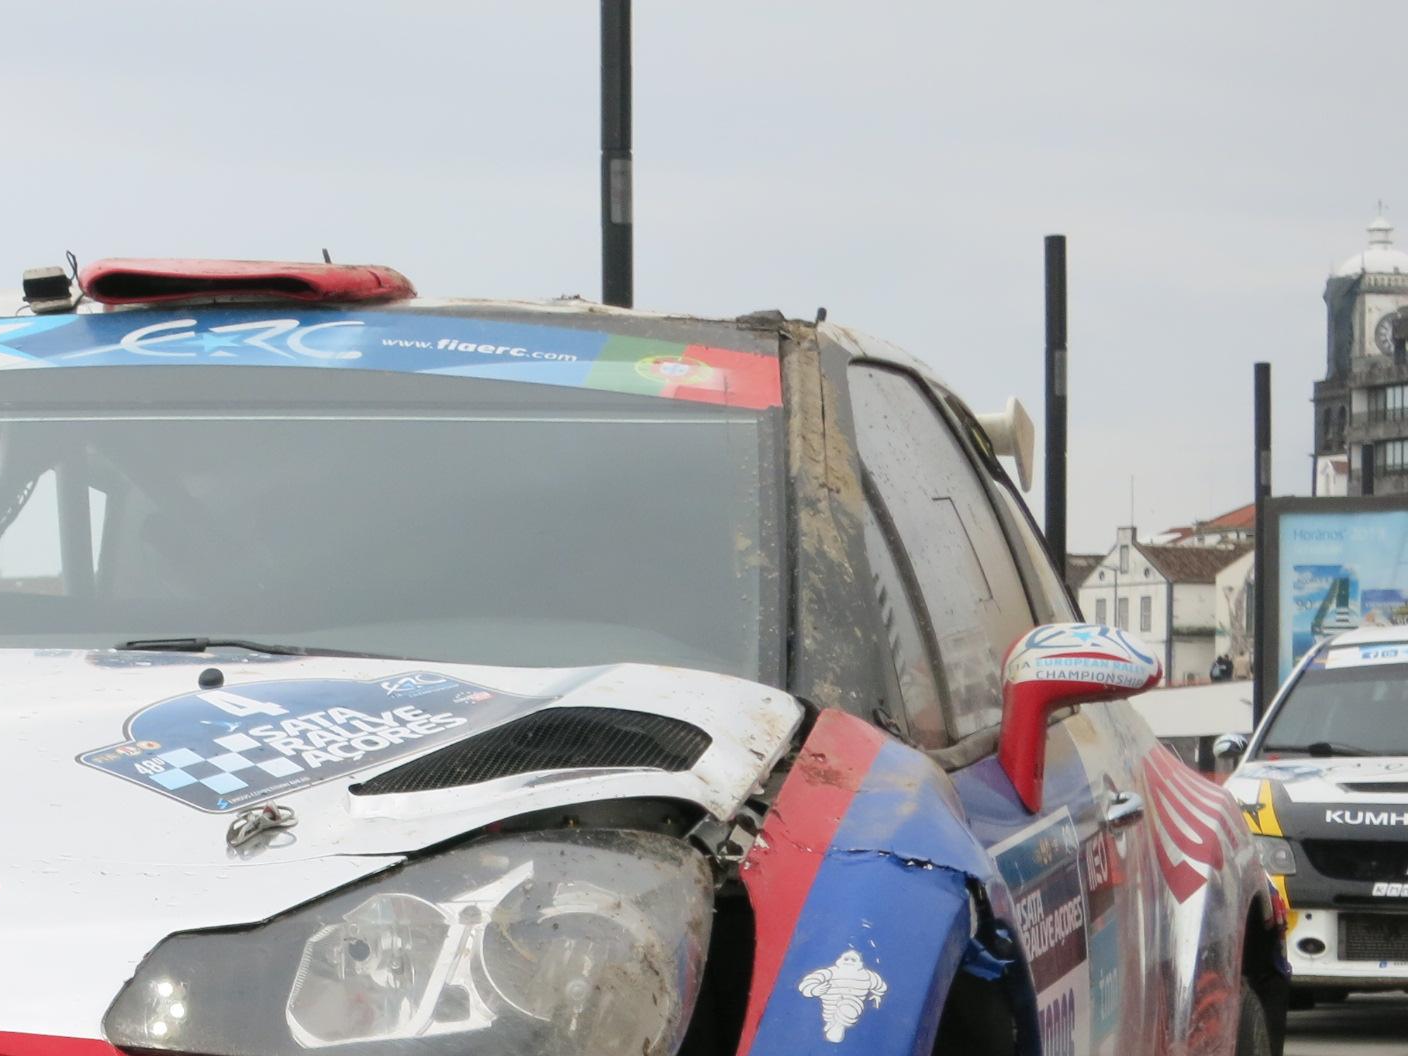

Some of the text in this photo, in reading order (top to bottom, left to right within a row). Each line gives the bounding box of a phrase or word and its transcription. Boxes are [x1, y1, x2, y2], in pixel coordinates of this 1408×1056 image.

[382, 338, 578, 362] www.fiaerc.com
[1035, 669, 1144, 689] CHAMPIONSHIP
[197, 690, 290, 717] 4
[248, 706, 362, 743] SATA
[269, 705, 425, 755] RALLYE
[301, 712, 468, 769] AÇORES
[1020, 889, 1045, 930] SATA
